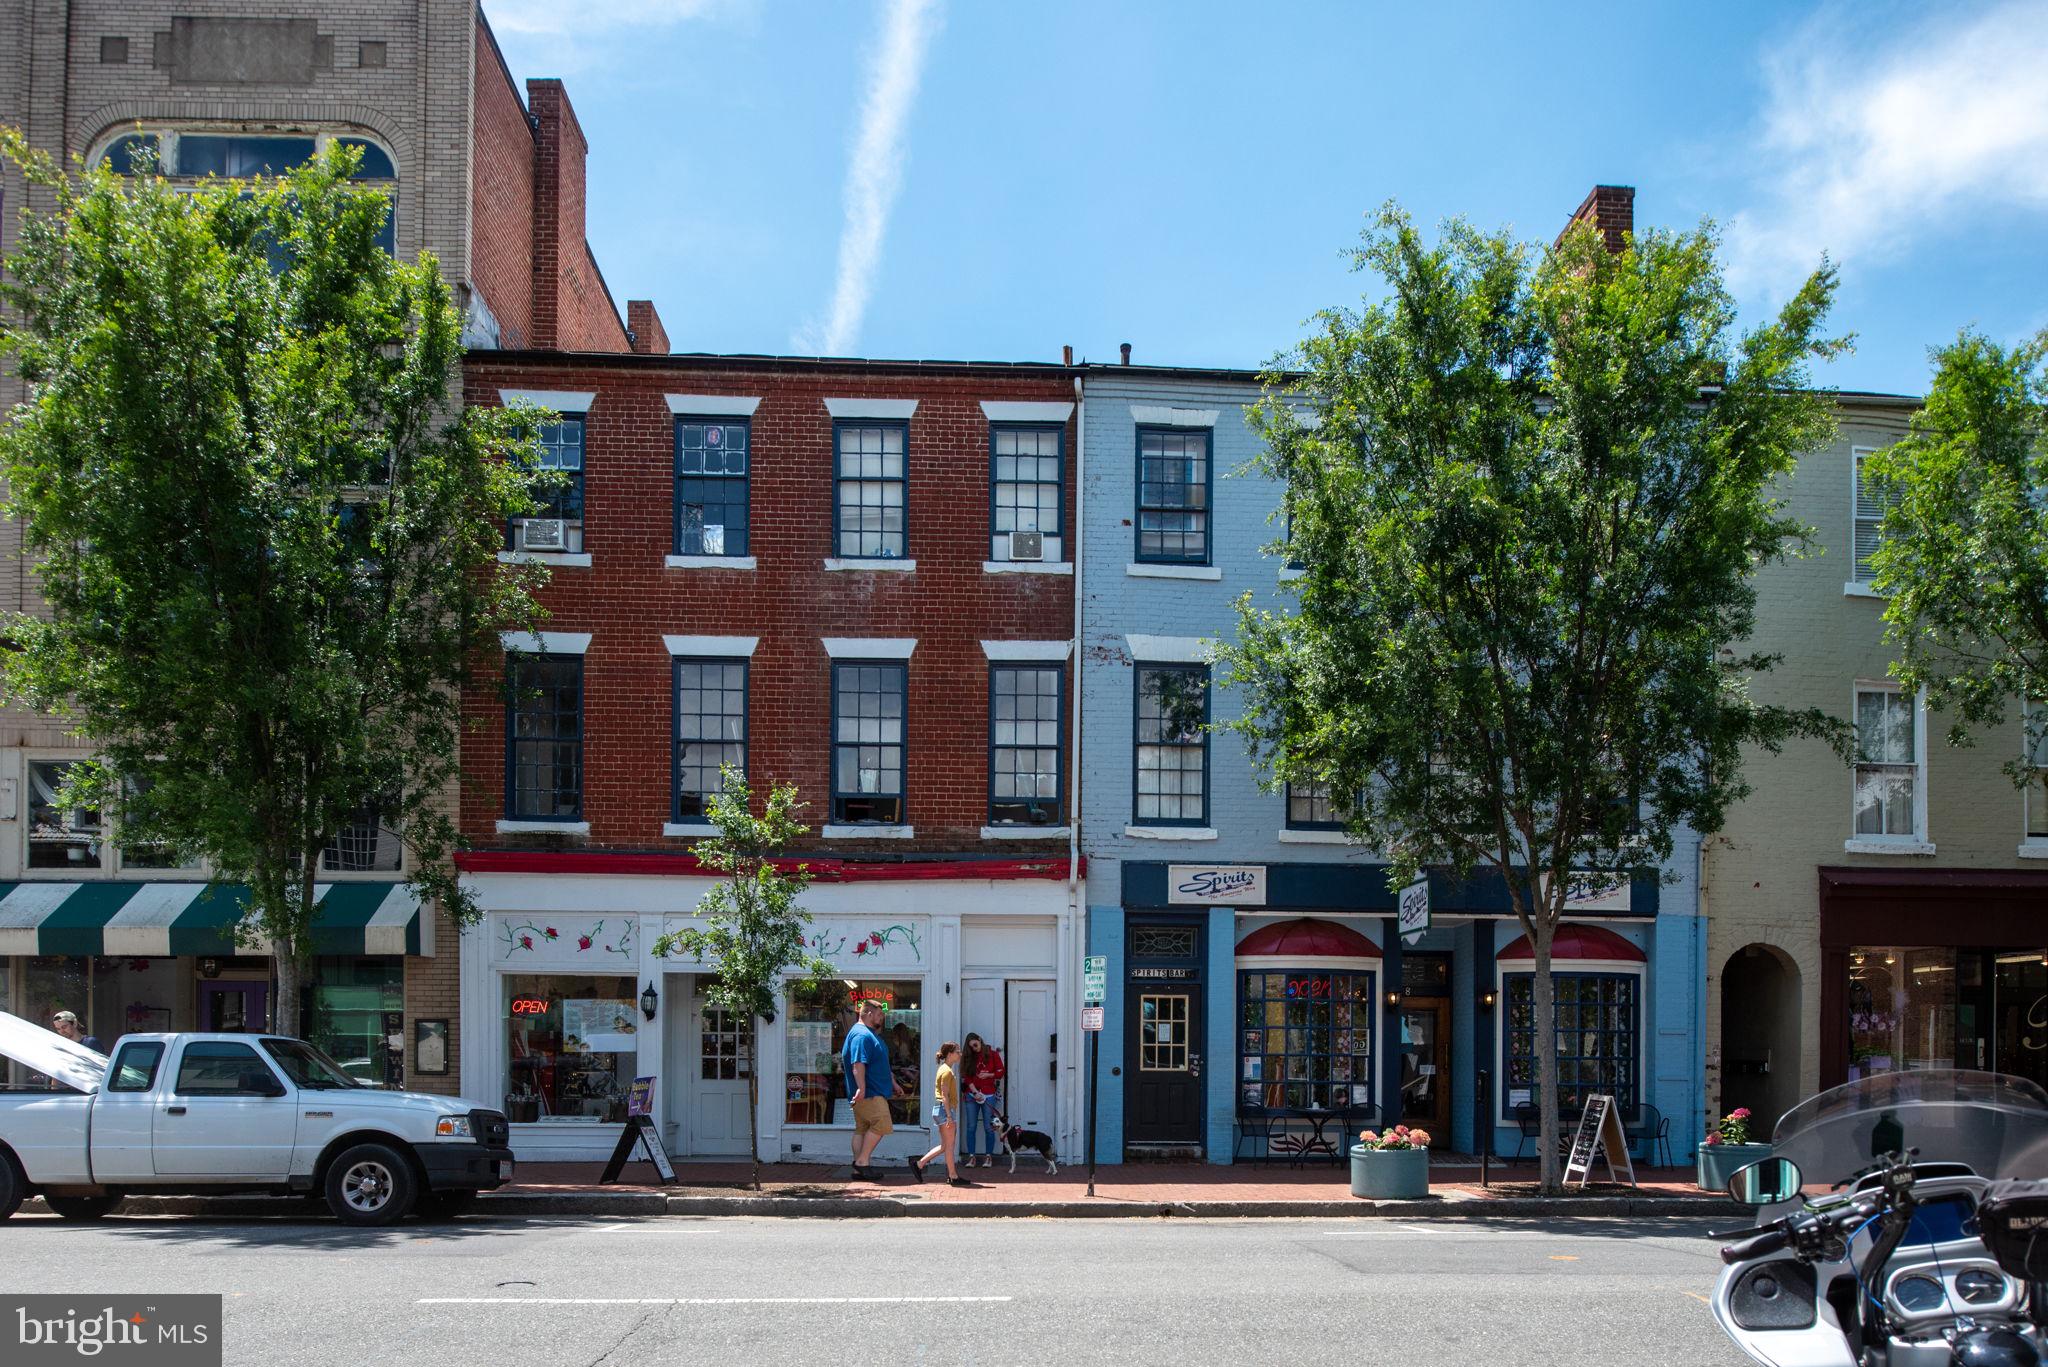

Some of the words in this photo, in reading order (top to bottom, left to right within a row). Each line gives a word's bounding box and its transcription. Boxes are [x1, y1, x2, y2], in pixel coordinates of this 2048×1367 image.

[1179, 871, 1255, 893] Spirits
[1085, 960, 1091, 972] 2
[1131, 969, 1167, 977] SPIRITS
[1169, 969, 1186, 977] BAR
[849, 985, 893, 1001] Bubble
[512, 1000, 548, 1014] OPEN
